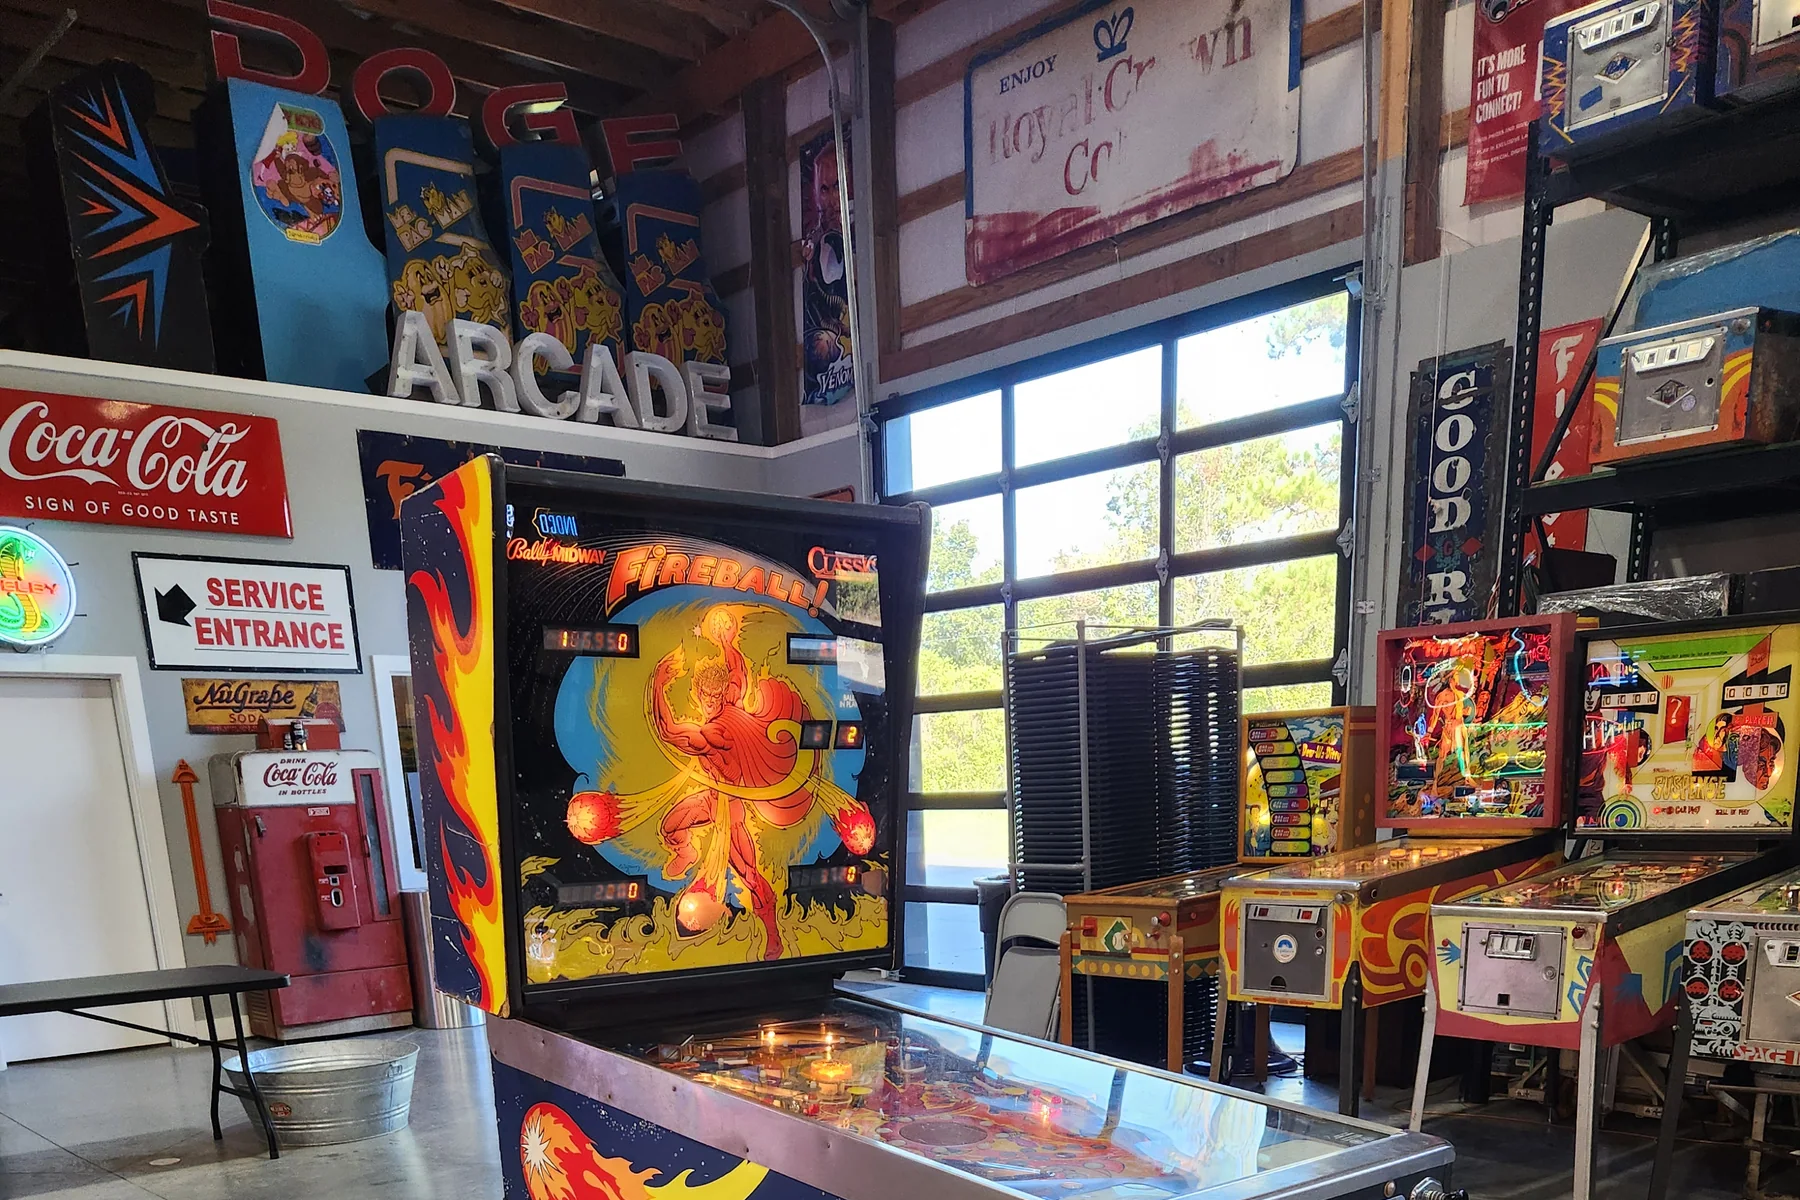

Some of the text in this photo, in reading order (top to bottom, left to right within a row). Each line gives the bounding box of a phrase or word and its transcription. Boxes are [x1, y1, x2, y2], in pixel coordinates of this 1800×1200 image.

[999, 55, 1057, 96] ENJOY
[1477, 43, 1527, 79] IT'S MORE
[1476, 72, 1510, 102] FUN TO
[1475, 90, 1523, 125] CONNECT!
[387, 311, 739, 442] ARCADE
[0, 400, 252, 499] Coca-Cola
[25, 495, 241, 527] SIGN OF GOOD TASTE
[506, 537, 607, 567] Bally MIDWAY
[206, 577, 325, 612] SERVICE
[194, 616, 345, 650] ENTRANCE
[192, 681, 296, 714] NuGrape
[228, 713, 265, 724] SODA
[847, 726, 858, 744] 2
[262, 761, 339, 788] Coca-Cola
[279, 757, 308, 765] DRINK
[290, 788, 328, 796] BOTTLES
[1651, 774, 1729, 801] SUSPENSE
[1733, 1044, 1788, 1065] SPACE
